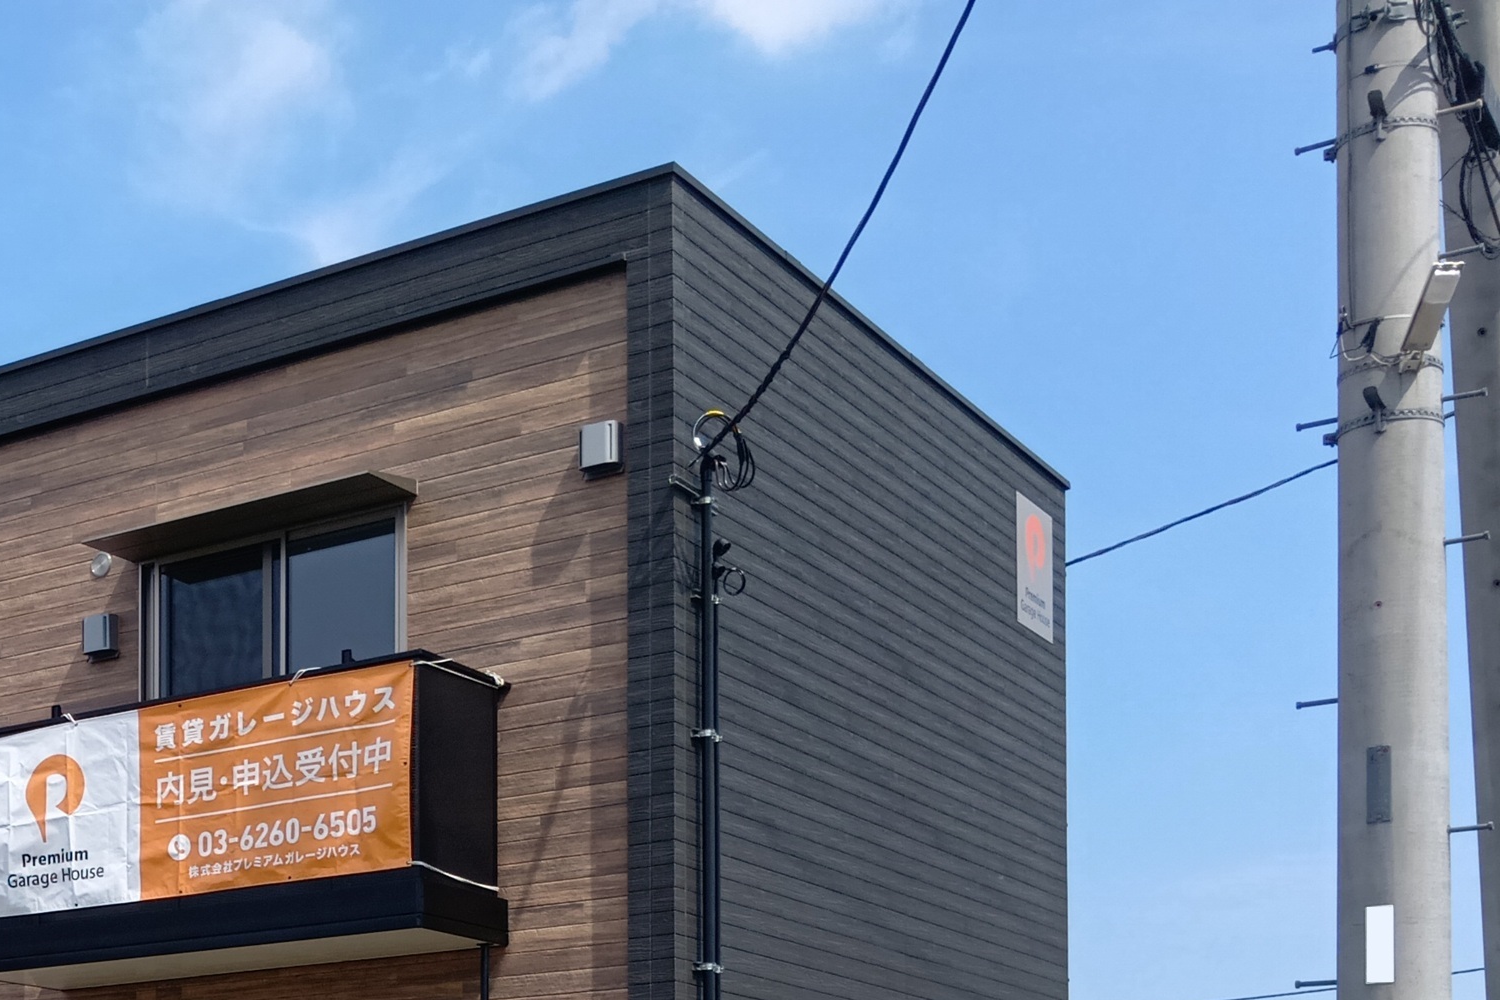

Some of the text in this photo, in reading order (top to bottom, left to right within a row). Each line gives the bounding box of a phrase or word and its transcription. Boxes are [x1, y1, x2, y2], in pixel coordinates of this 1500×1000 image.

[154, 686, 396, 752] 賃貸ガレージハウス
[156, 737, 391, 809] 内見・申込受付中
[198, 806, 377, 857] 03-6260-6505
[7, 866, 104, 888] Garage House
[22, 848, 88, 867] Premium
[188, 843, 361, 879] 株式会社プレミアムガレージハウス
